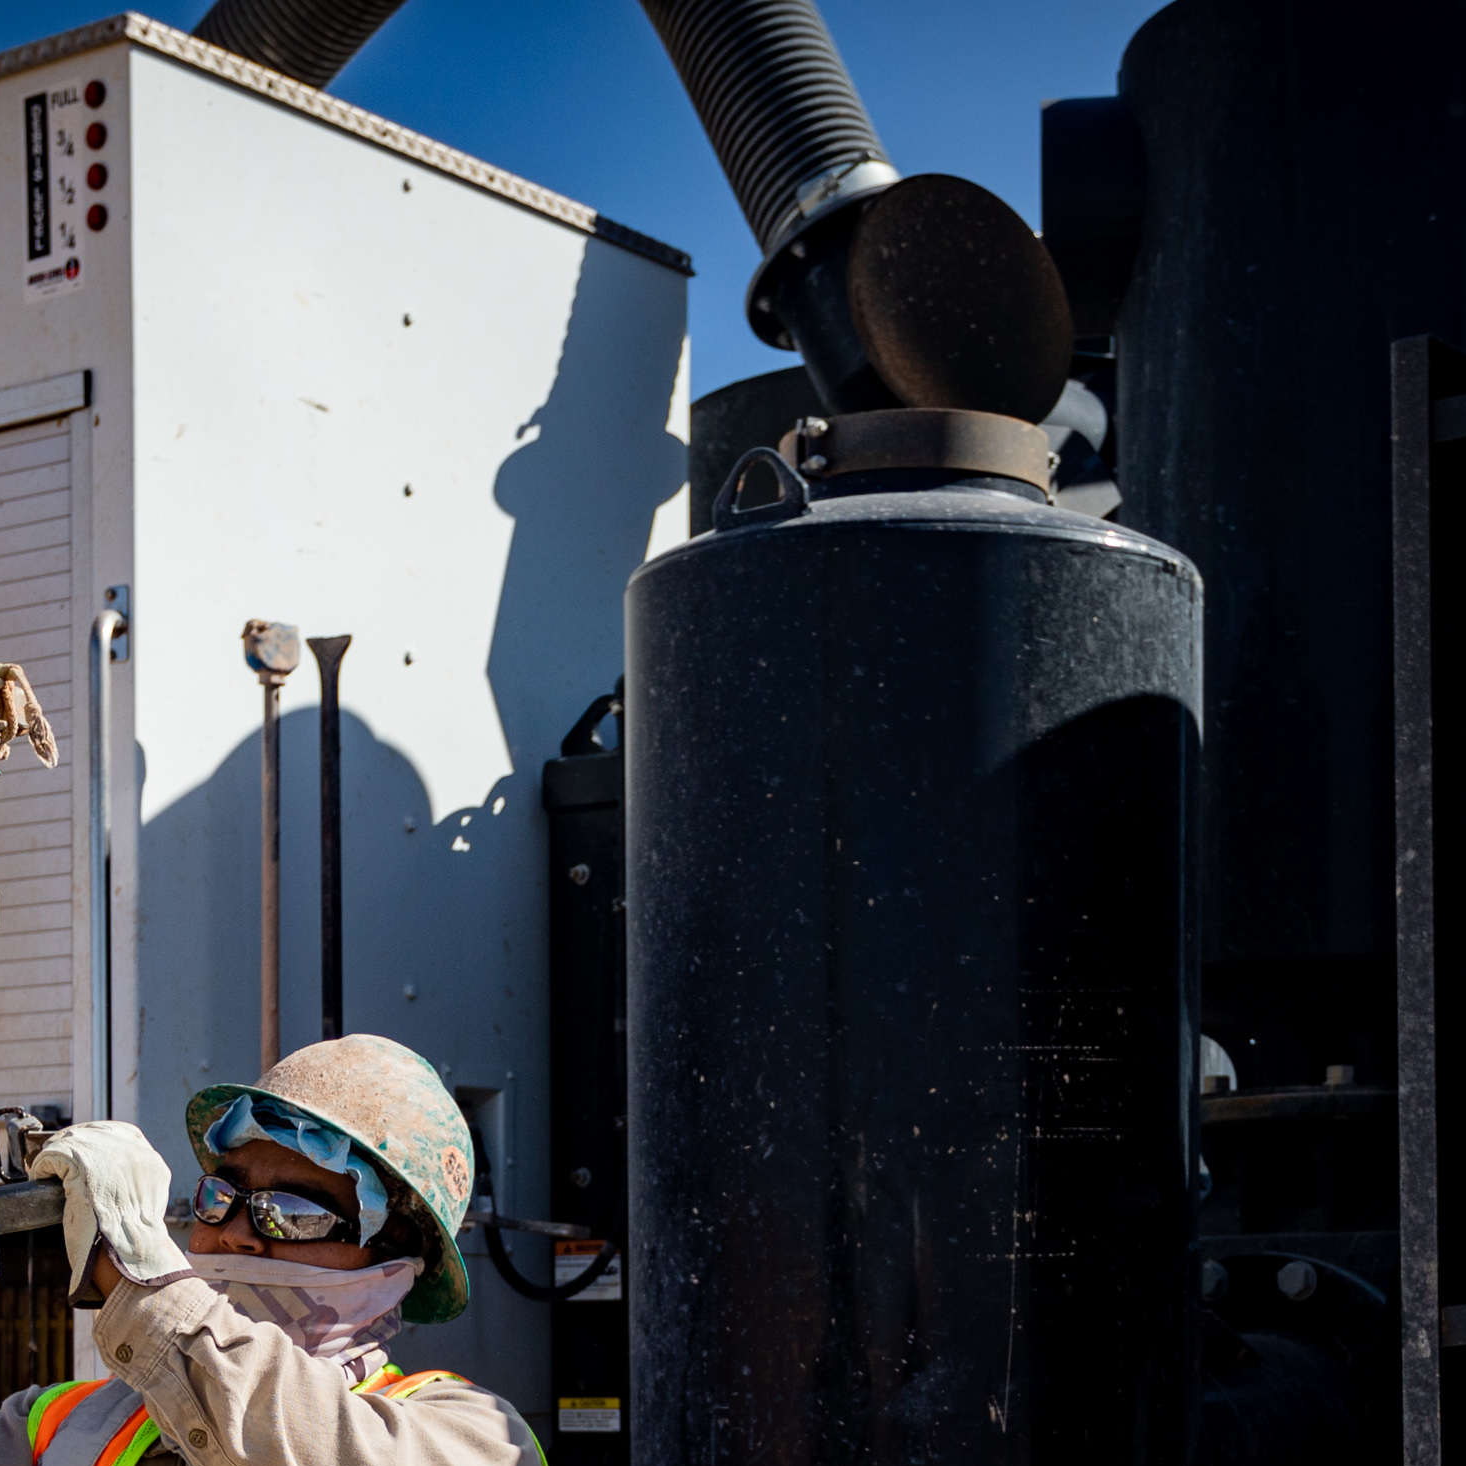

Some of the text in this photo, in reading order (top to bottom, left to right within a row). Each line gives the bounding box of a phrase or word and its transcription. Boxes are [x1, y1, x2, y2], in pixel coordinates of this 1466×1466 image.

[51, 88, 79, 109] FULL
[30, 103, 45, 251] DEBRIS LEVEL
